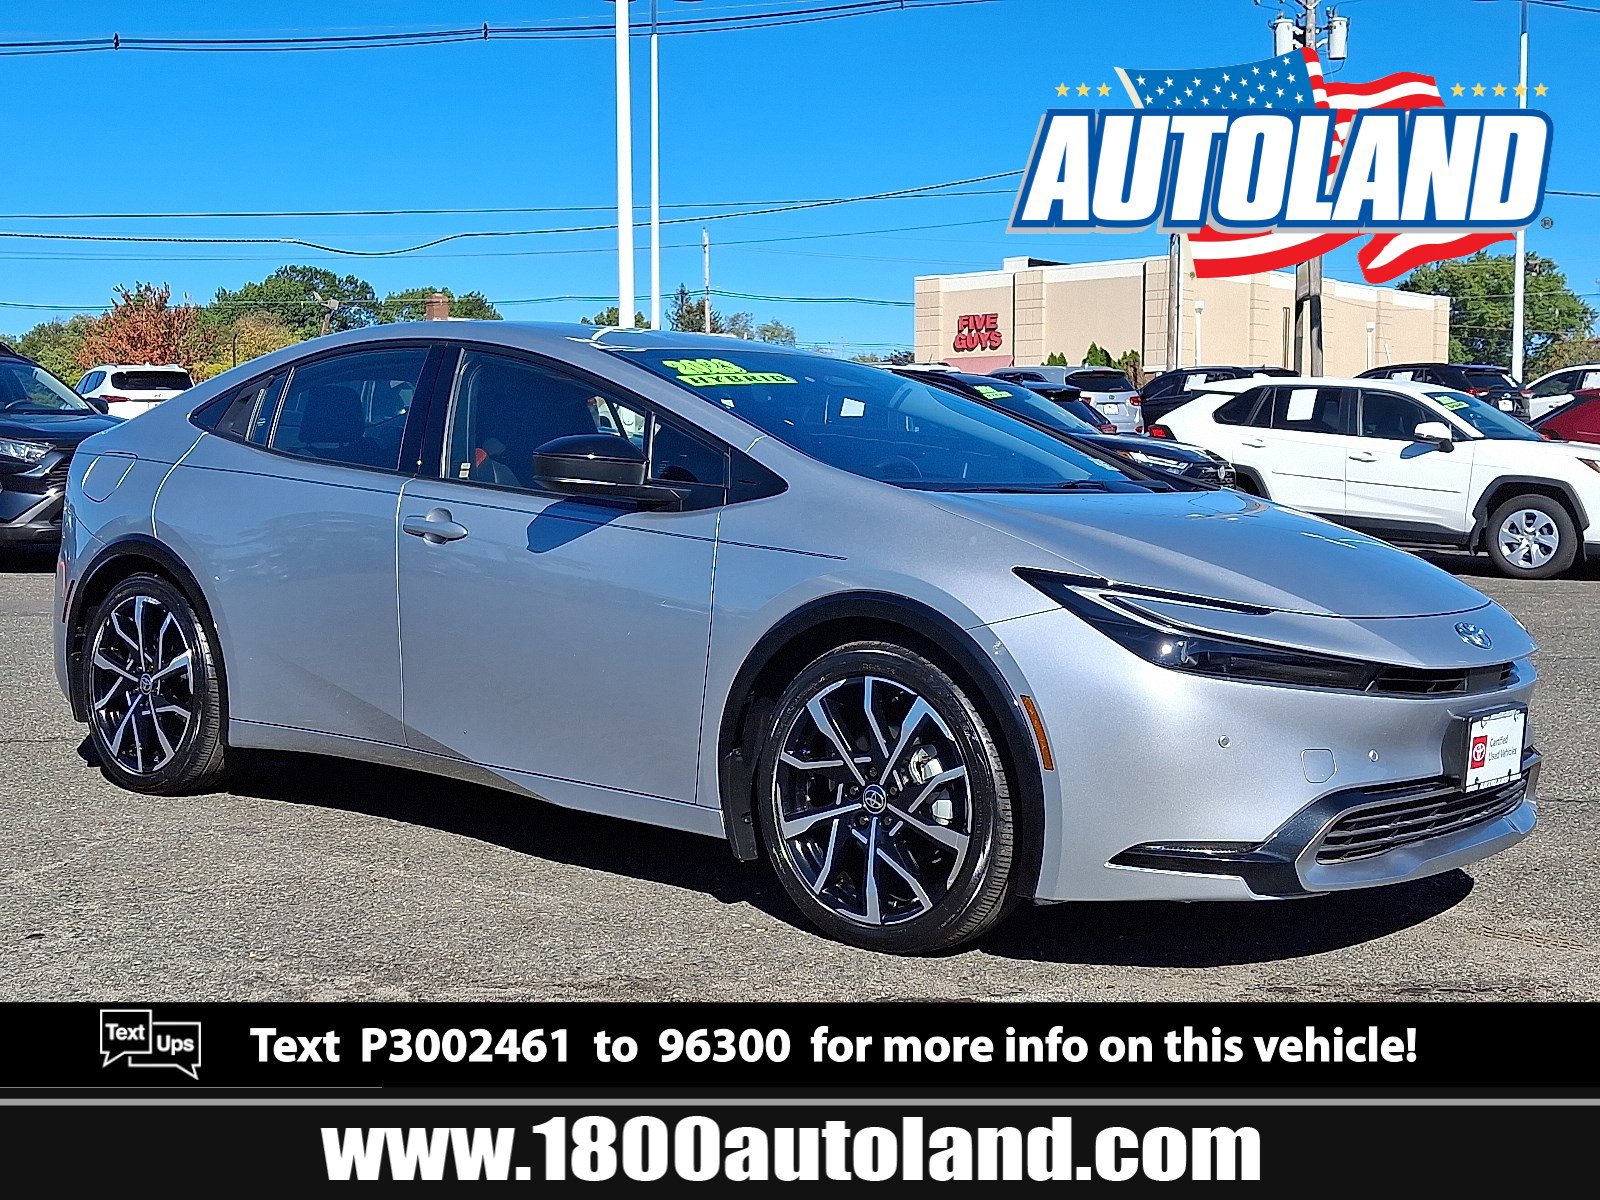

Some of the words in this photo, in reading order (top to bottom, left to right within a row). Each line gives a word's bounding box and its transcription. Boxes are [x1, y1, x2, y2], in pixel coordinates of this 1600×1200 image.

[958, 313, 998, 332] FIVE
[953, 331, 1002, 352] GUYS
[687, 374, 789, 385] HYBRID
[1490, 735, 1508, 747] Certified
[1489, 750, 1500, 761] Used
[1500, 746, 1517, 757] Vehicles
